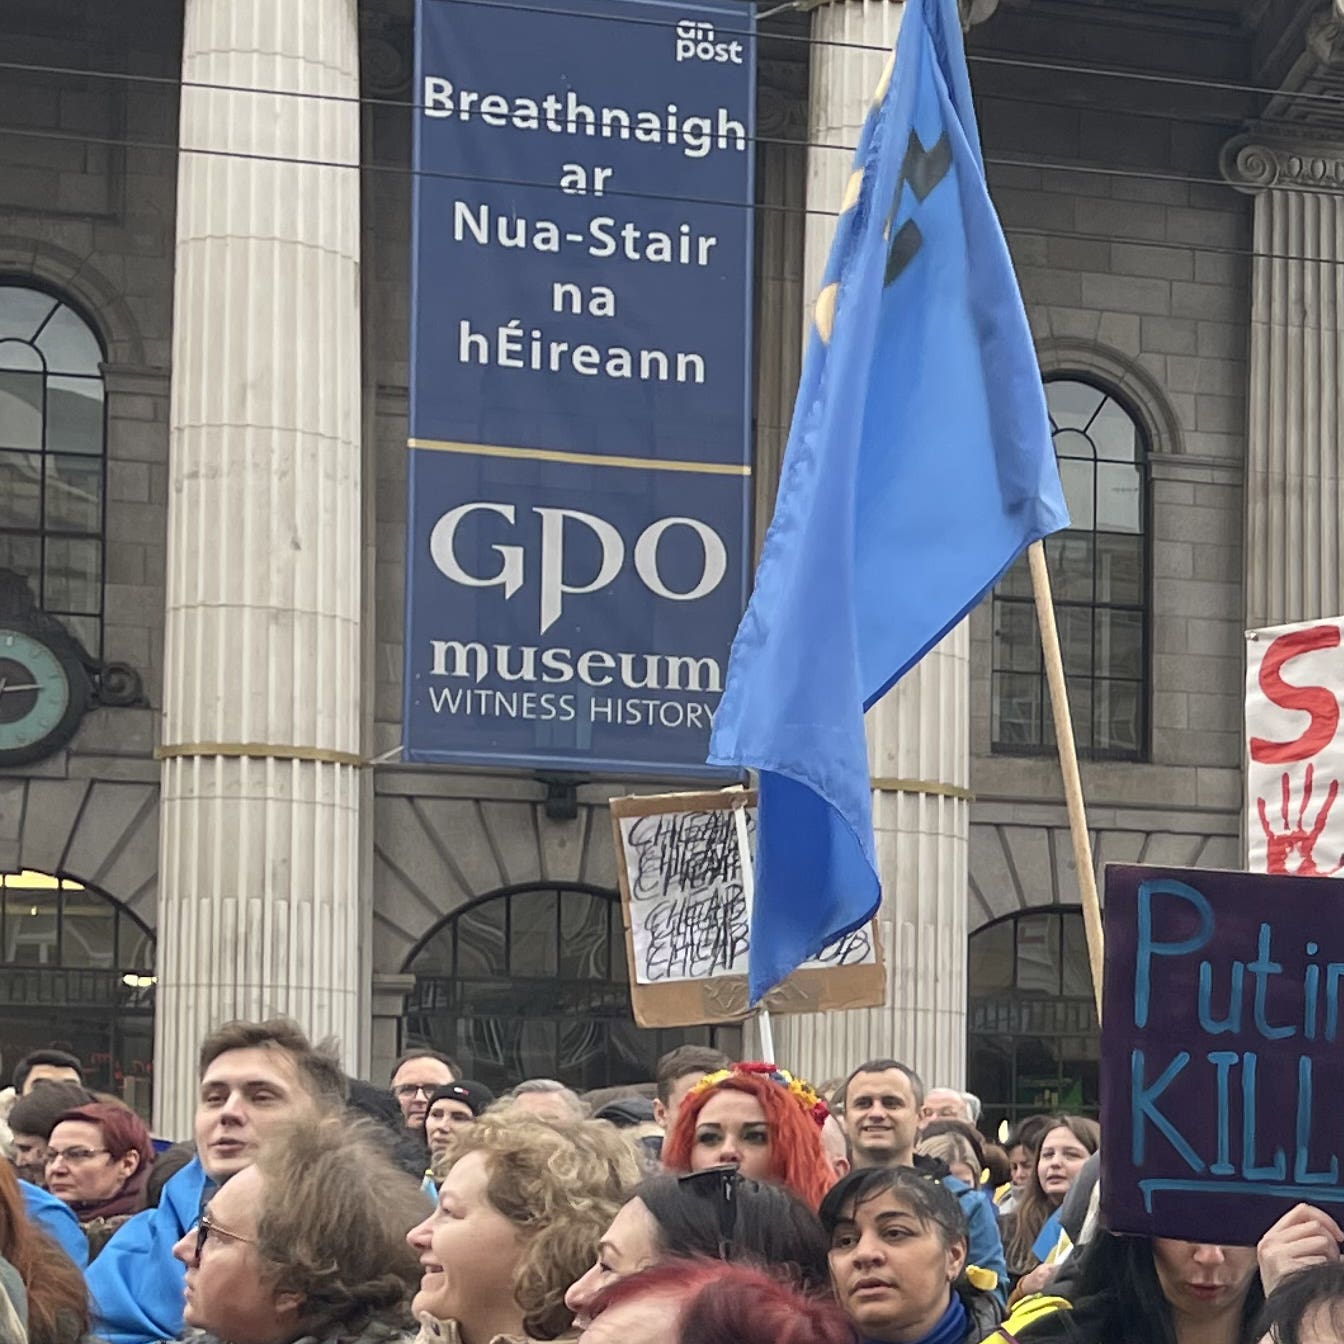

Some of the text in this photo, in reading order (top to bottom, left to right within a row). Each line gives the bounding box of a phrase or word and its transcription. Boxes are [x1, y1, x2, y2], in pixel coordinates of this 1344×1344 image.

[676, 20, 714, 41] an
[676, 40, 743, 64] post
[424, 76, 746, 158] Breathnaigh
[561, 162, 612, 196] ar
[453, 201, 716, 266] Nua-Stair
[553, 280, 616, 318] na
[459, 321, 705, 384] hÉireann
[430, 639, 723, 691] museum
[430, 687, 575, 721] WITNESS
